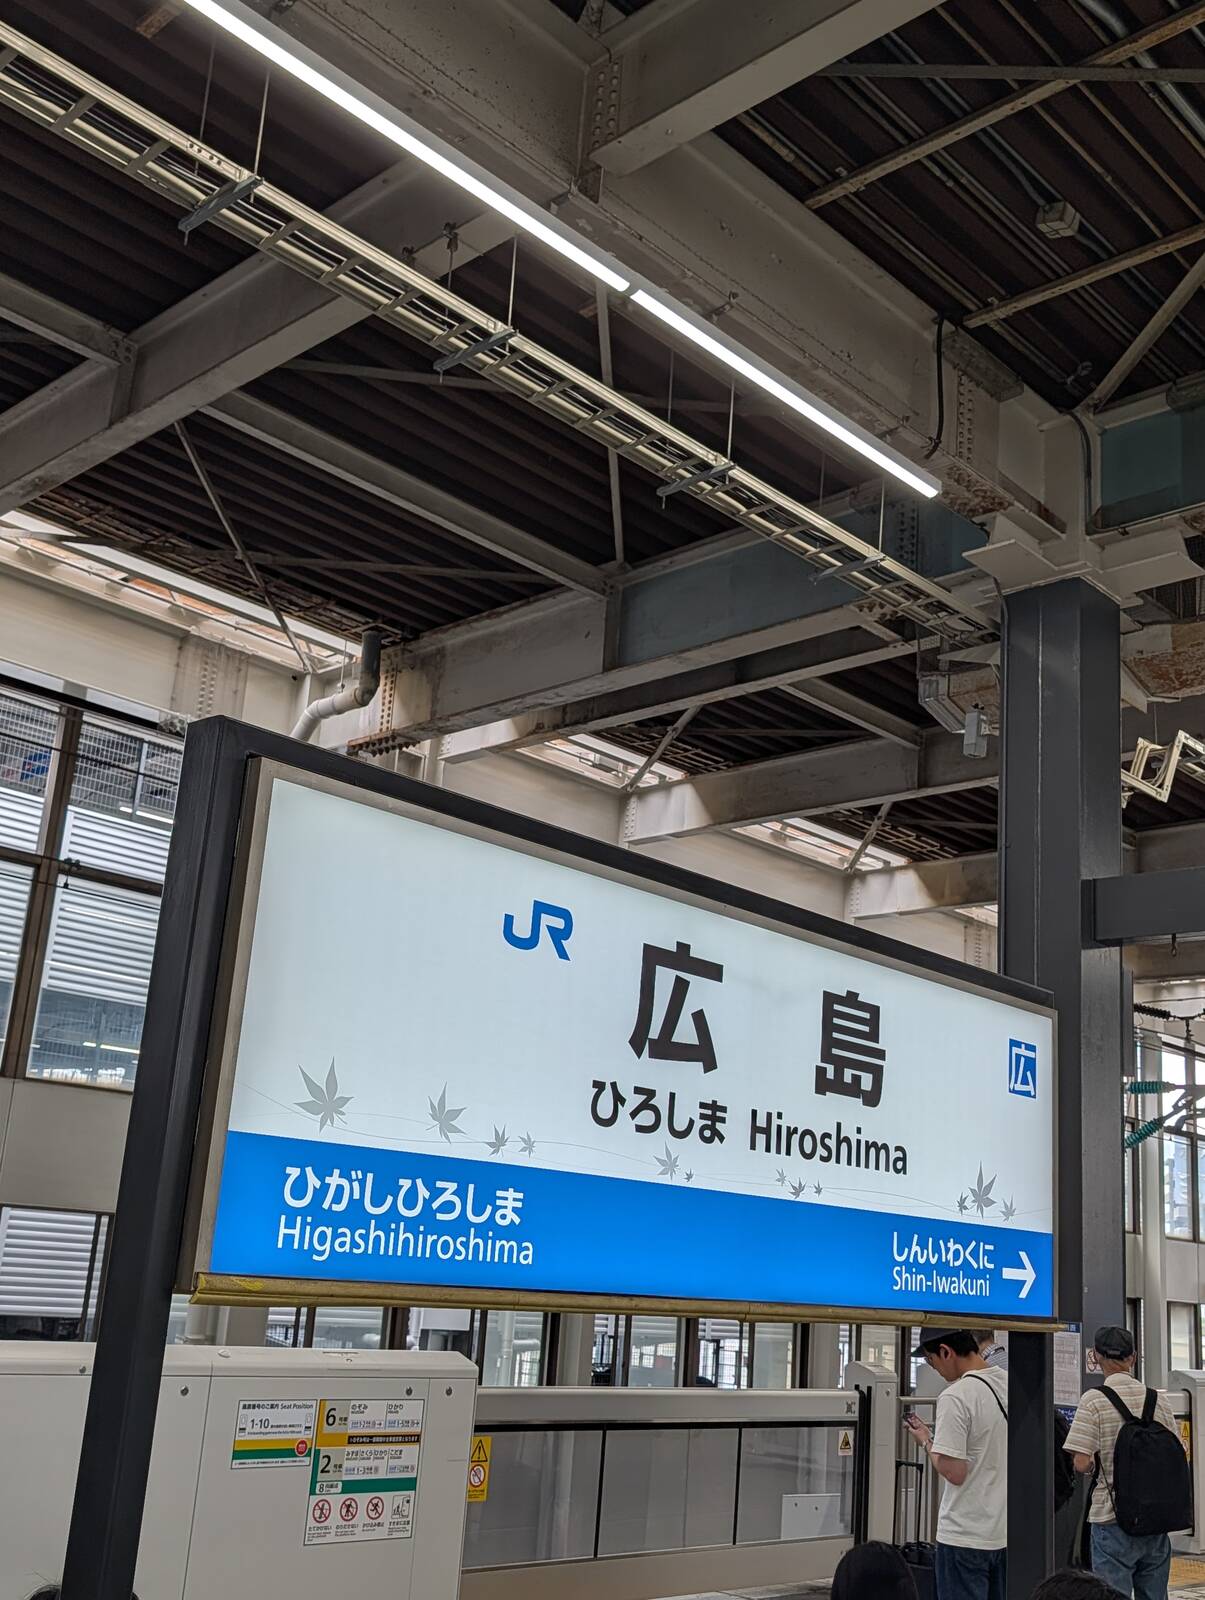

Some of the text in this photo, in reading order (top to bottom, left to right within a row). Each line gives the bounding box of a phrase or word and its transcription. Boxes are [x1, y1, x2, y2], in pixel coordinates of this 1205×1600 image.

[503, 900, 574, 962] JR
[1009, 1043, 1036, 1097] 広
[591, 1079, 908, 1176] ひろしま Hiroshima
[283, 1166, 525, 1226] ひがしひろしま
[276, 1214, 534, 1265] Higashihiroshima
[892, 1231, 995, 1270] しんいわくに
[892, 1265, 990, 1297] Shin-Iwakuni
[250, 1418, 270, 1429] 1-10
[280, 1402, 292, 1410] Seat
[292, 1402, 314, 1410] Position
[325, 1407, 337, 1427] 6
[320, 1454, 331, 1474] 2
[318, 1483, 325, 1493] 8
